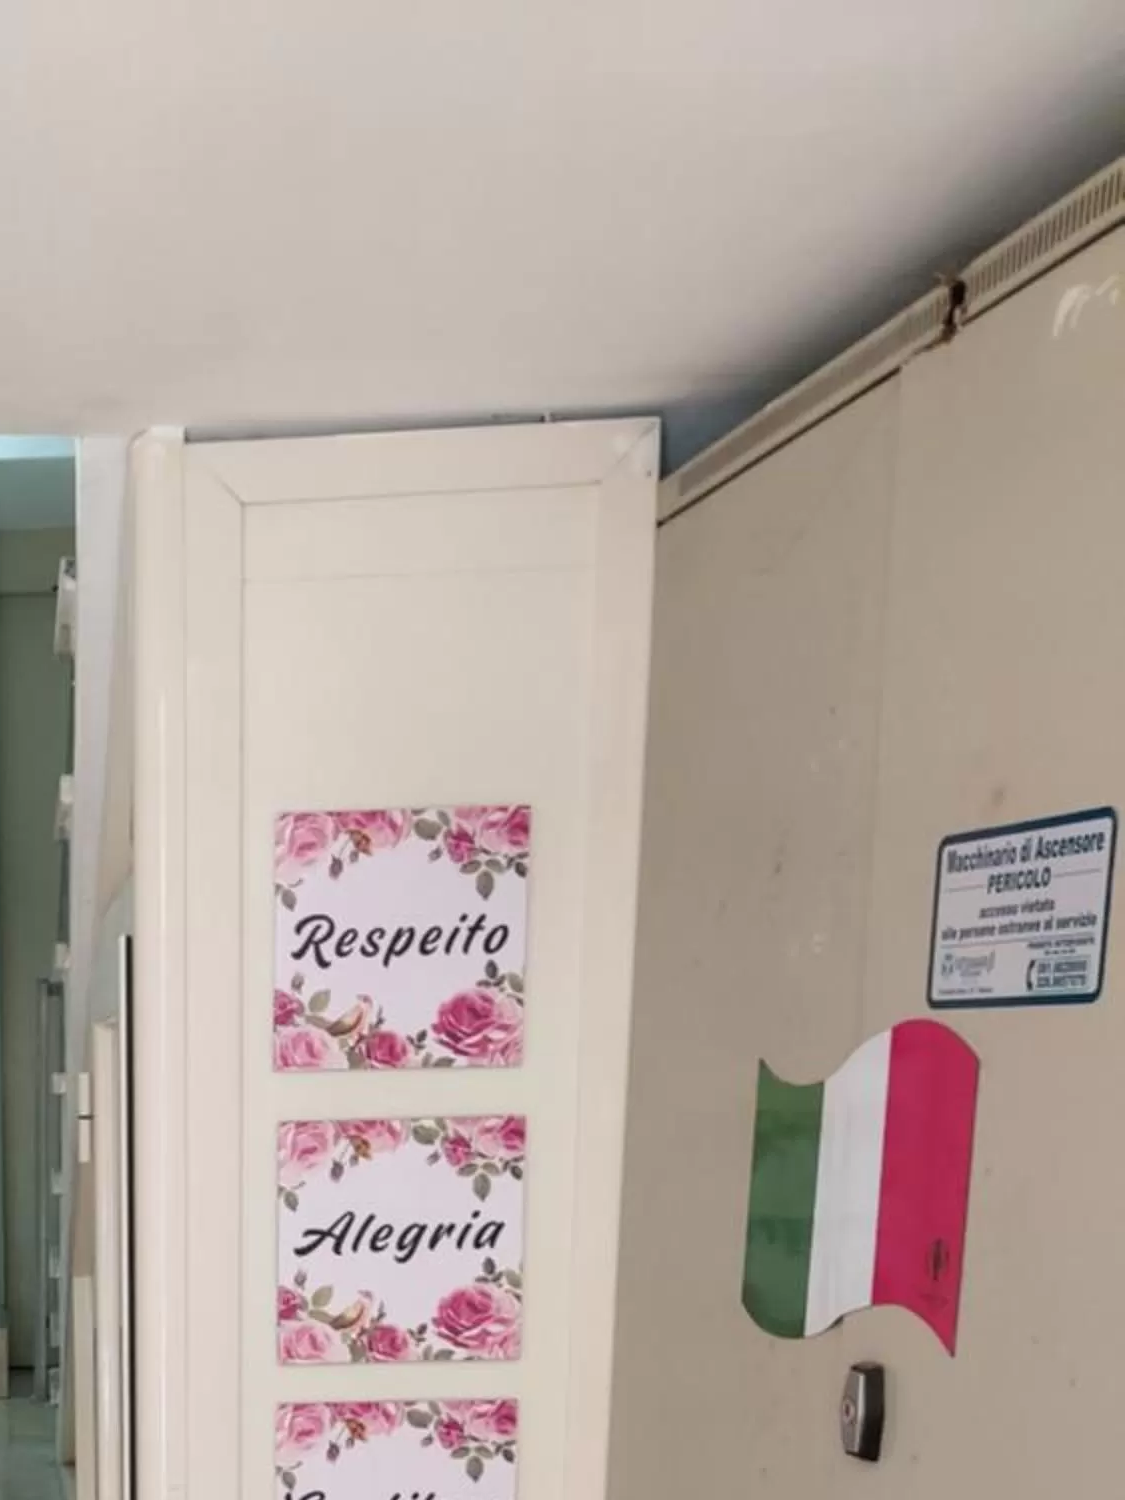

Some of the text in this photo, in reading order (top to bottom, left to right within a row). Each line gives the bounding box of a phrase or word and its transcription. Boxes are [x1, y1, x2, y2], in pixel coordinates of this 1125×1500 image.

[1019, 837, 1032, 863] di
[1034, 832, 1105, 860] Ascensore
[987, 866, 1051, 894] PERICOLO
[291, 913, 510, 969] Respeito
[293, 1210, 506, 1264] Alegria
